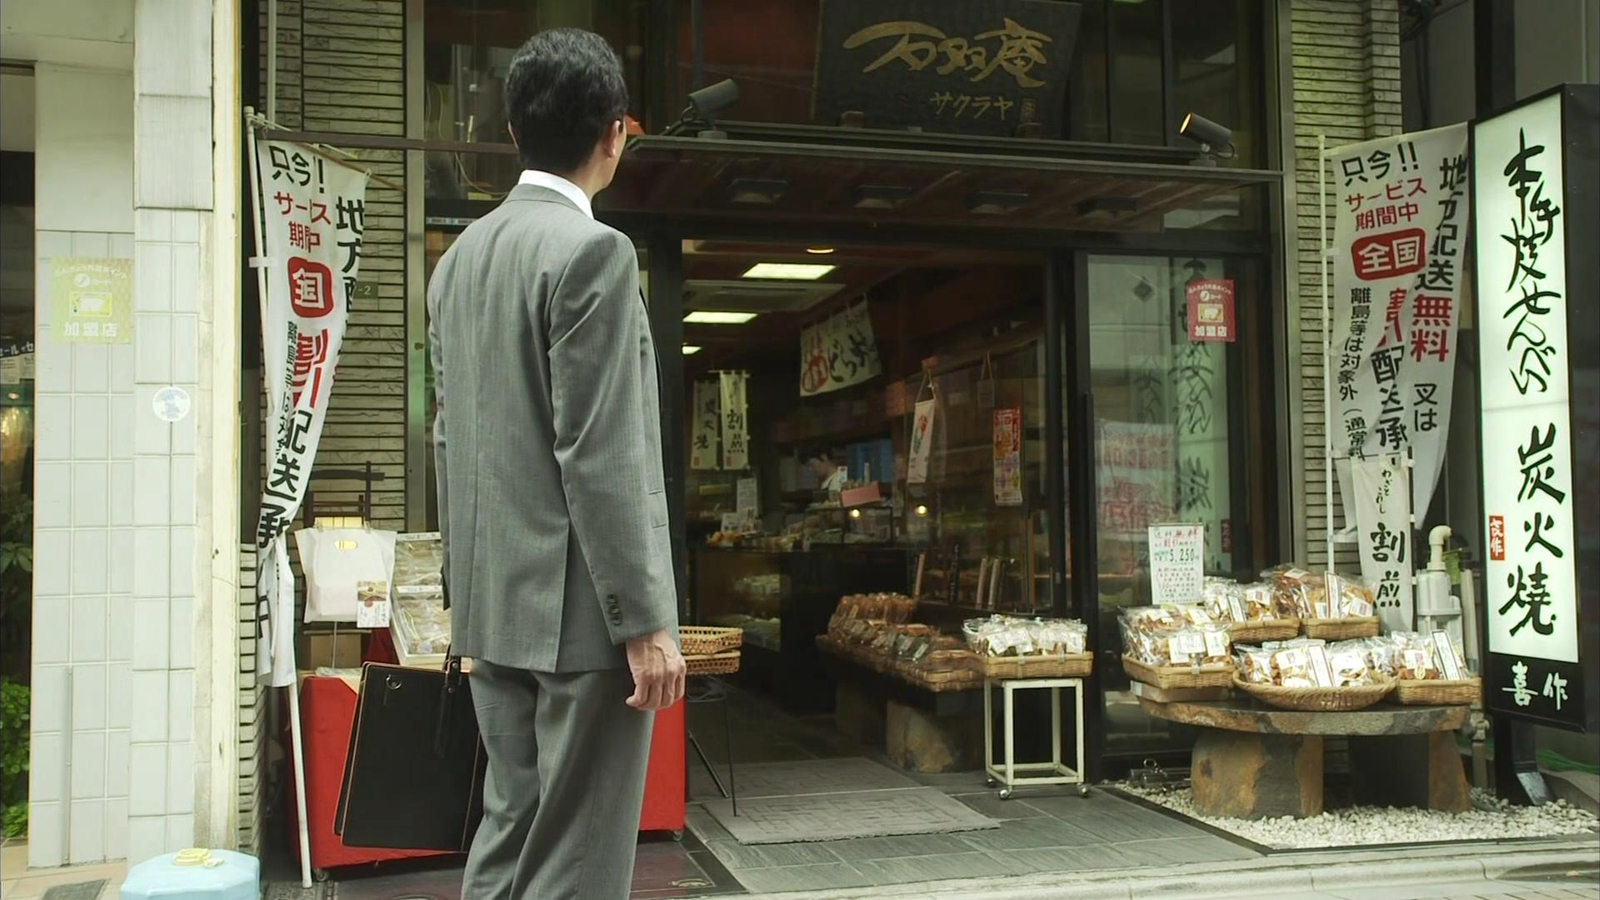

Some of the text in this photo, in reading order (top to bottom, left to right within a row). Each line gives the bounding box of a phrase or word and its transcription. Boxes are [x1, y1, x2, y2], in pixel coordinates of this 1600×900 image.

[930, 92, 1014, 120] サクラヤ
[1345, 177, 1428, 213] サービス
[1355, 202, 1420, 232] 期間中
[1359, 236, 1421, 274] 全国
[64, 321, 119, 338] 加盟店
[1501, 660, 1569, 711] 喜作
